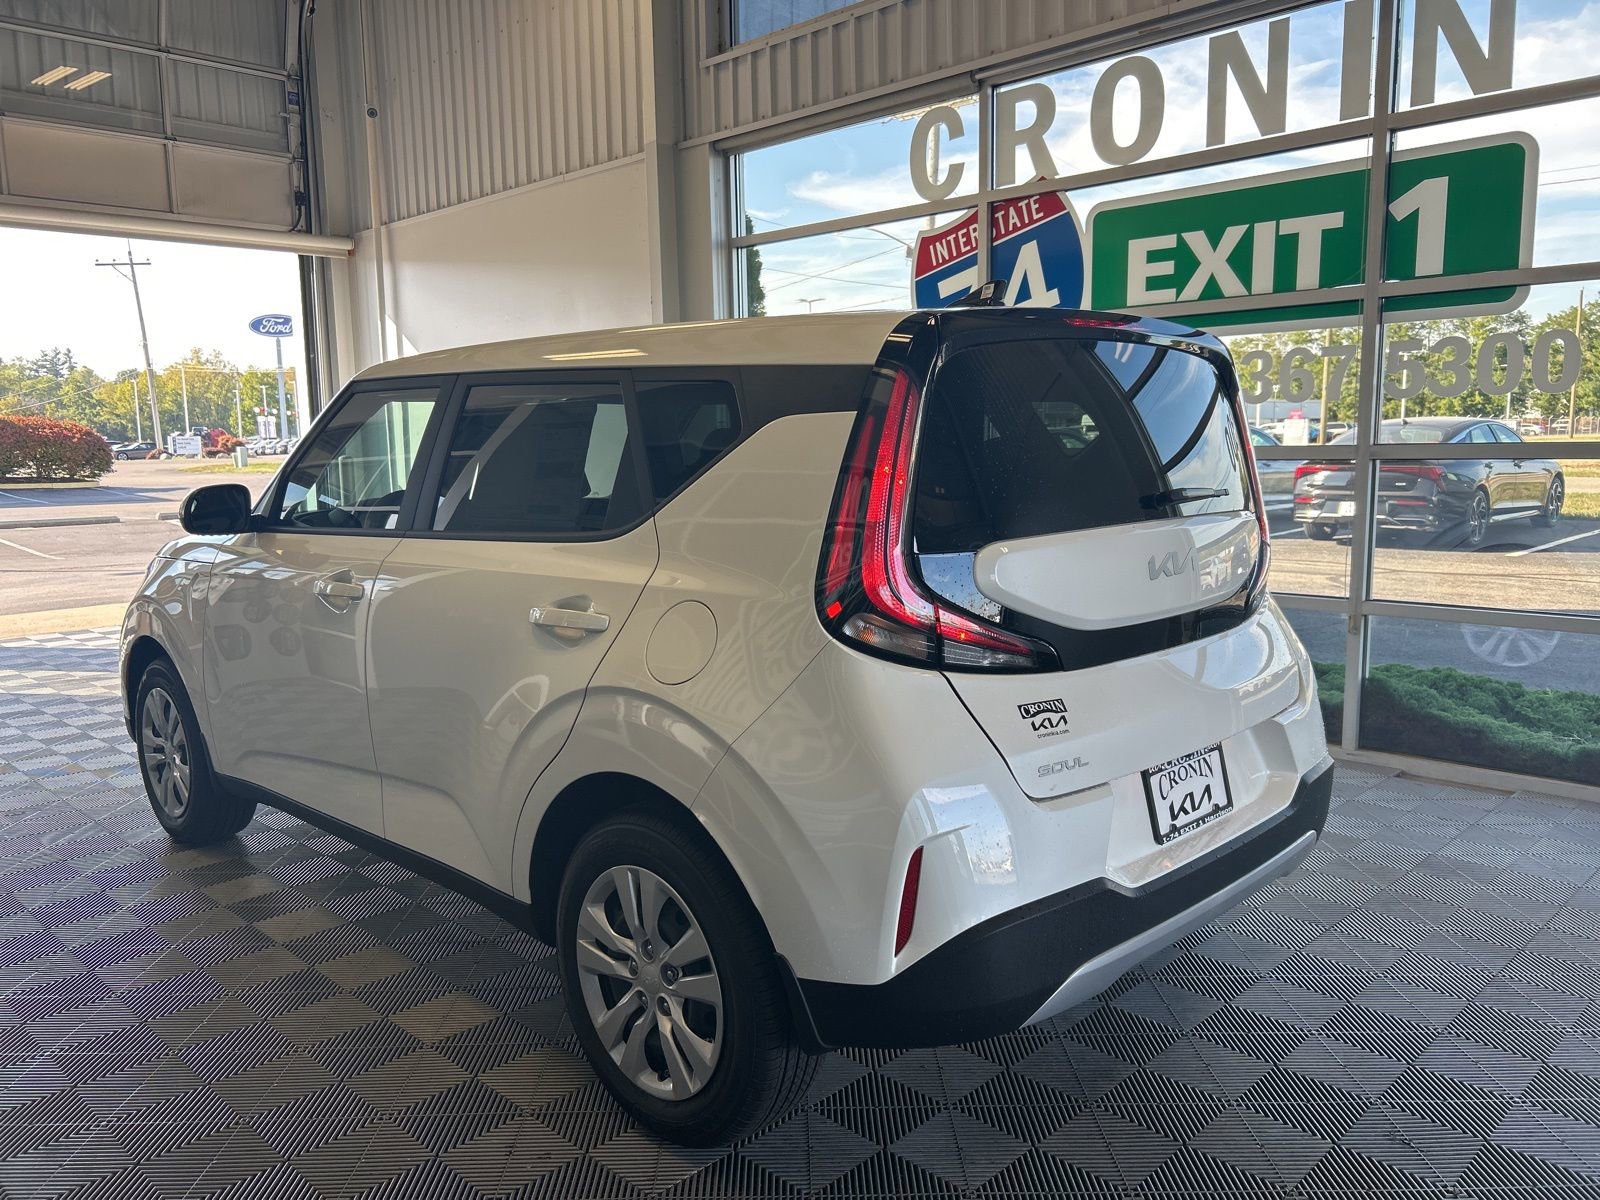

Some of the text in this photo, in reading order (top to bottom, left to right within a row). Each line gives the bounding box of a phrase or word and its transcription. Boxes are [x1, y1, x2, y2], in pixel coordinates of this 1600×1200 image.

[909, 0, 1517, 201] CRONIN
[1126, 176, 1449, 307] EXIT 1
[260, 317, 292, 333] Ford
[1240, 328, 1583, 404] 367 5300
[1148, 546, 1196, 581] KIA
[1020, 700, 1065, 718] CRONIN
[1031, 715, 1068, 731] KIA
[1038, 757, 1090, 778] SOUL
[1158, 754, 1214, 801] CRONIN
[1168, 783, 1213, 822] KIA
[1162, 832, 1179, 844] I-74
[1180, 822, 1197, 835] EXIT
[1204, 806, 1233, 823] Harrison
